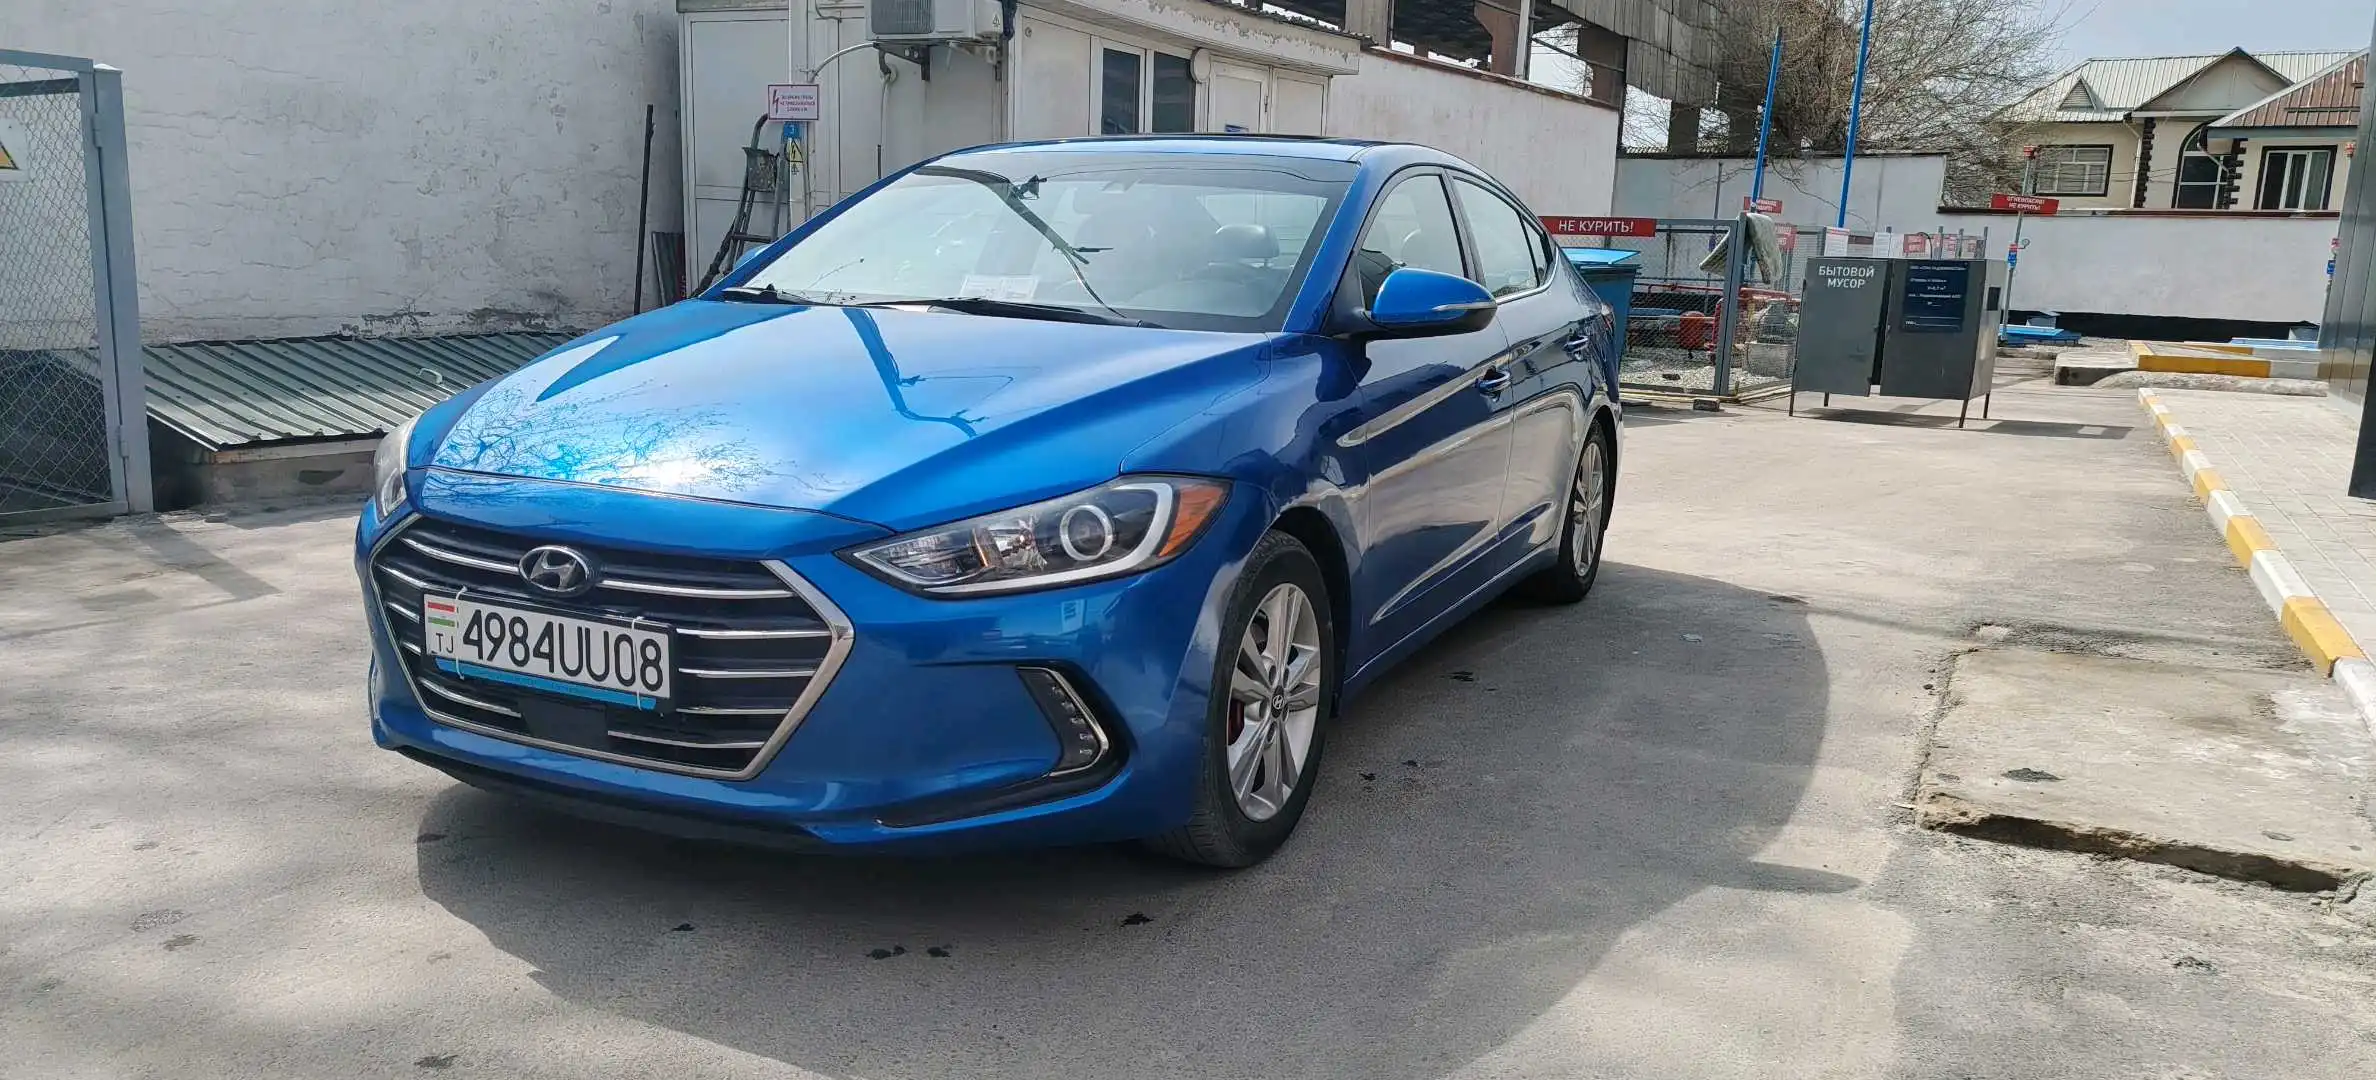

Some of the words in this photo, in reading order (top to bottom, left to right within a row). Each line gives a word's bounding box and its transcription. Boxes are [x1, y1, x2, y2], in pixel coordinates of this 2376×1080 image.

[1558, 220, 1575, 232] НЕ
[1579, 220, 1634, 233] КУРИТЬ!
[1818, 265, 1875, 278] БЫТОВОЙ
[1827, 277, 1866, 289] МУСОР
[436, 632, 455, 655] TJ
[462, 609, 664, 692] 4984UU08
